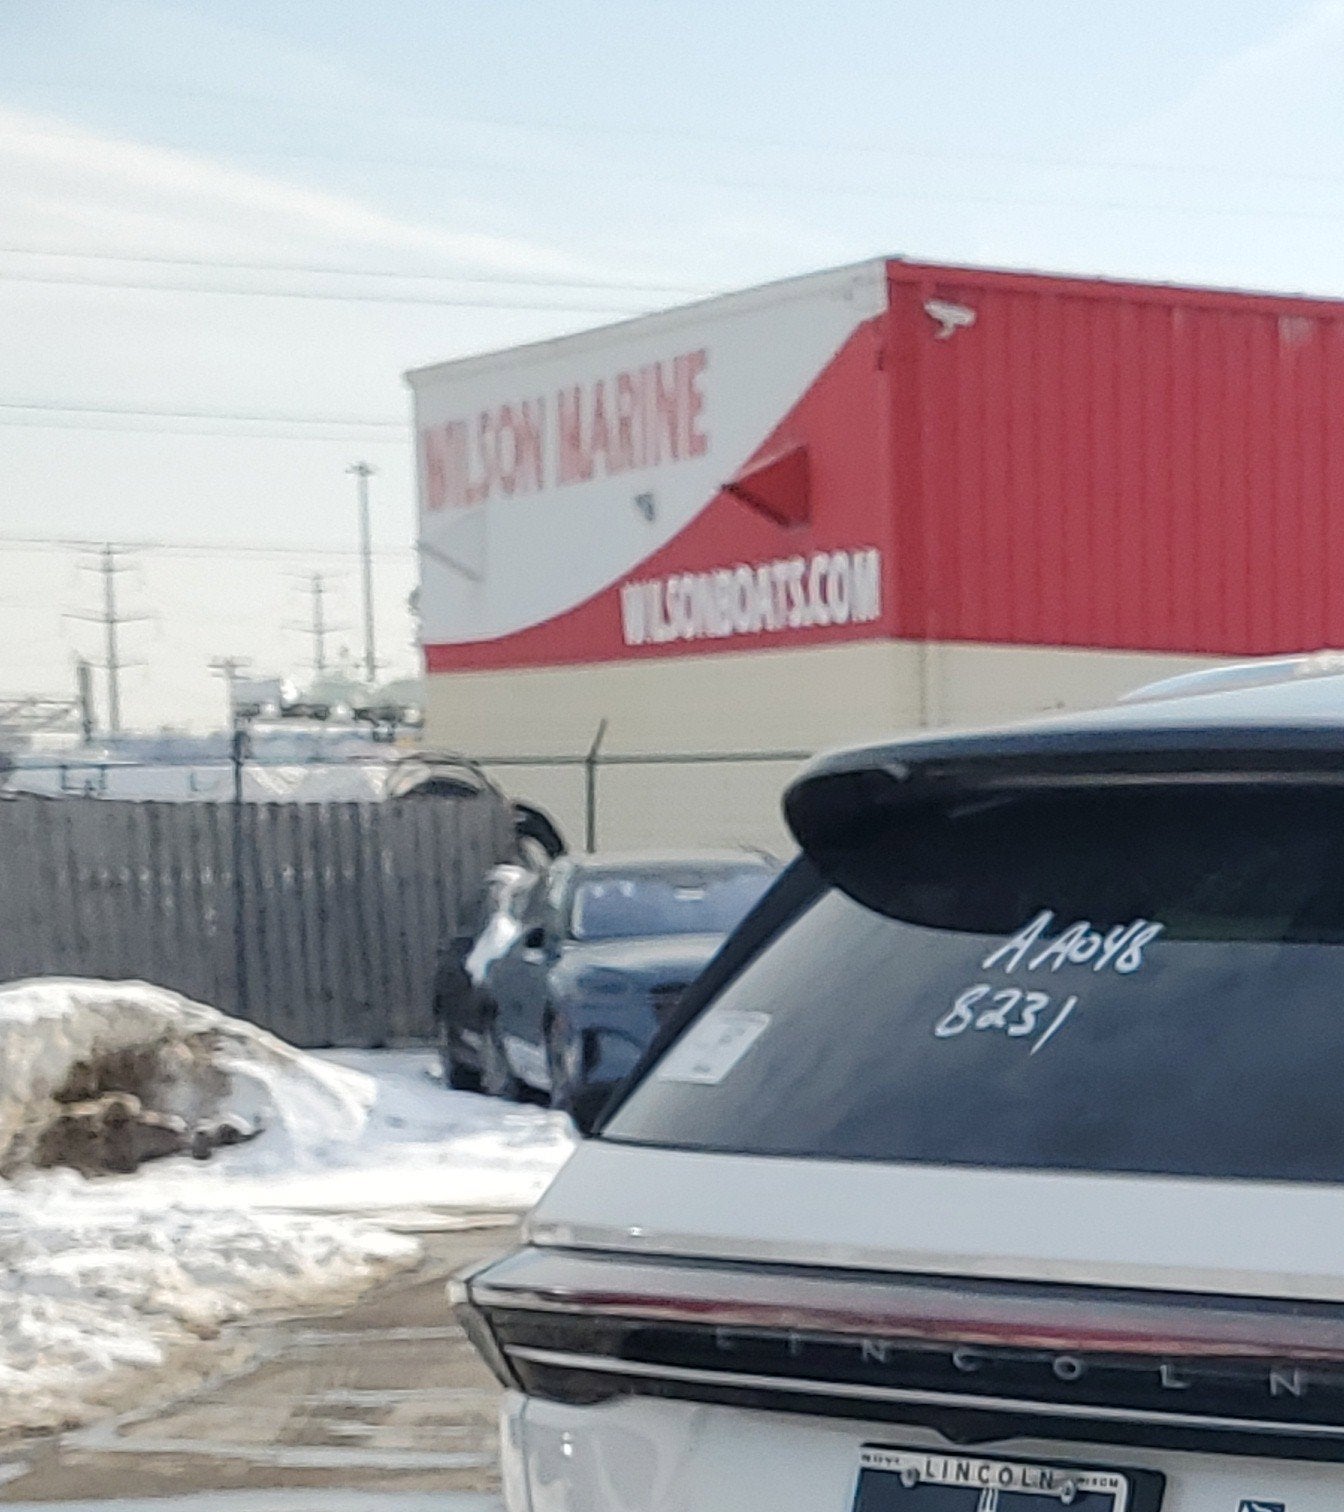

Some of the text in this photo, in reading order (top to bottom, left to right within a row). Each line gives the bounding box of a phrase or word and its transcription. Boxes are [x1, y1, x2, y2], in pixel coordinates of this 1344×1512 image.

[424, 348, 708, 511] WILSON MARINE
[620, 548, 881, 646] WILSONBOATS.COM
[715, 1325, 1303, 1397] LINCOLN
[925, 1457, 1055, 1490] LINCOLN
